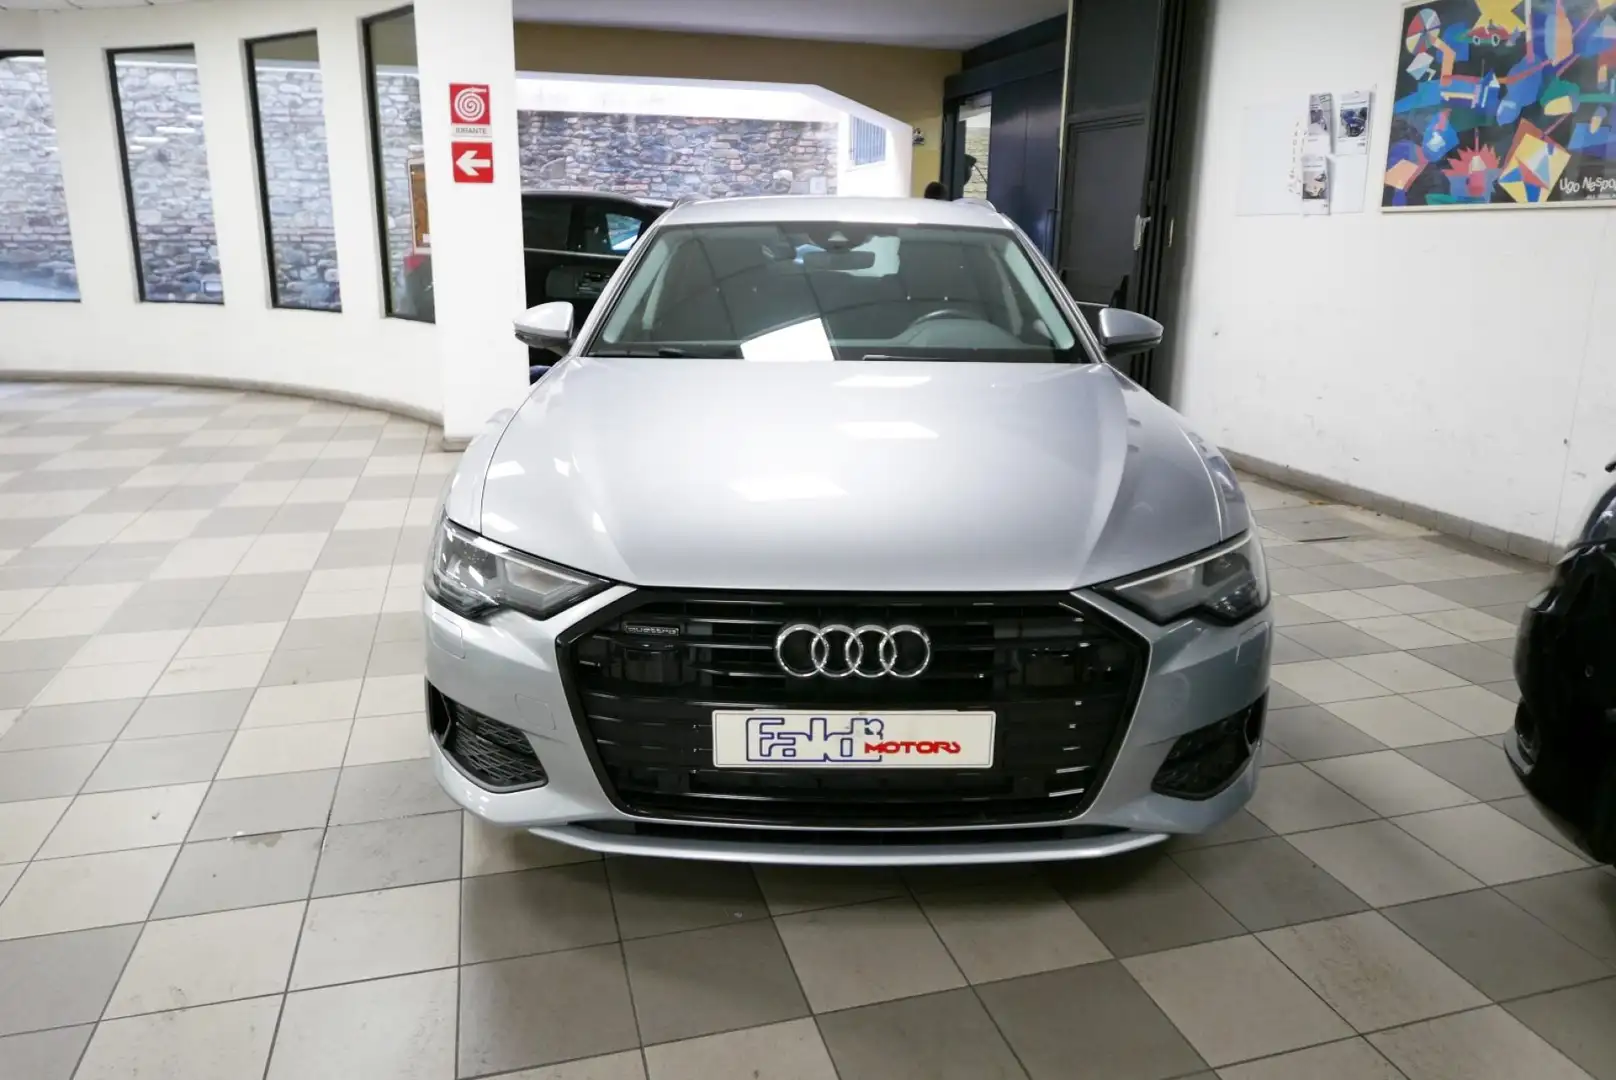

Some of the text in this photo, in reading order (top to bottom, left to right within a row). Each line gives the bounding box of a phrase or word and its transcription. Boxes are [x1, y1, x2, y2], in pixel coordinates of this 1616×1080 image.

[1560, 176, 1616, 194] Ugo Nespo
[864, 740, 962, 755] MOTORS
